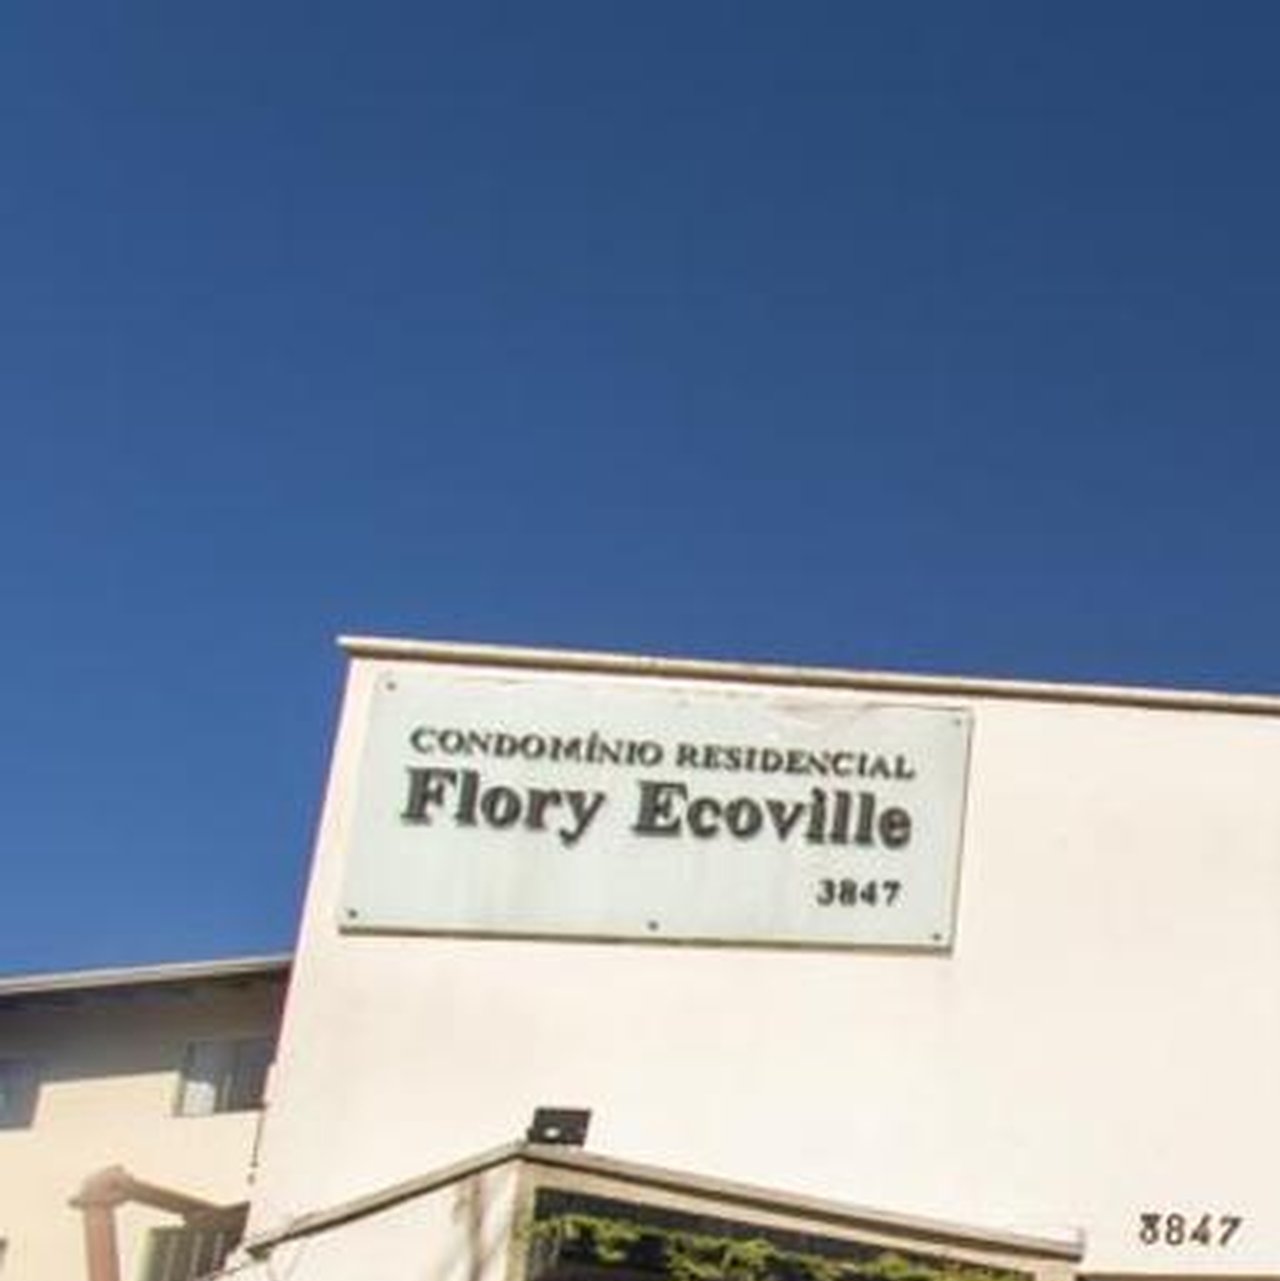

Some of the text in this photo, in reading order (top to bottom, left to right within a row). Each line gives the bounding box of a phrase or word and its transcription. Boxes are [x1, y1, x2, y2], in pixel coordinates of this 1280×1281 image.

[410, 728, 915, 780] CONDOMÍNIO RESIDENCIAL
[401, 767, 913, 849] Flory Ecoville
[817, 879, 901, 907] 3847
[1139, 1213, 1242, 1246] 3847
